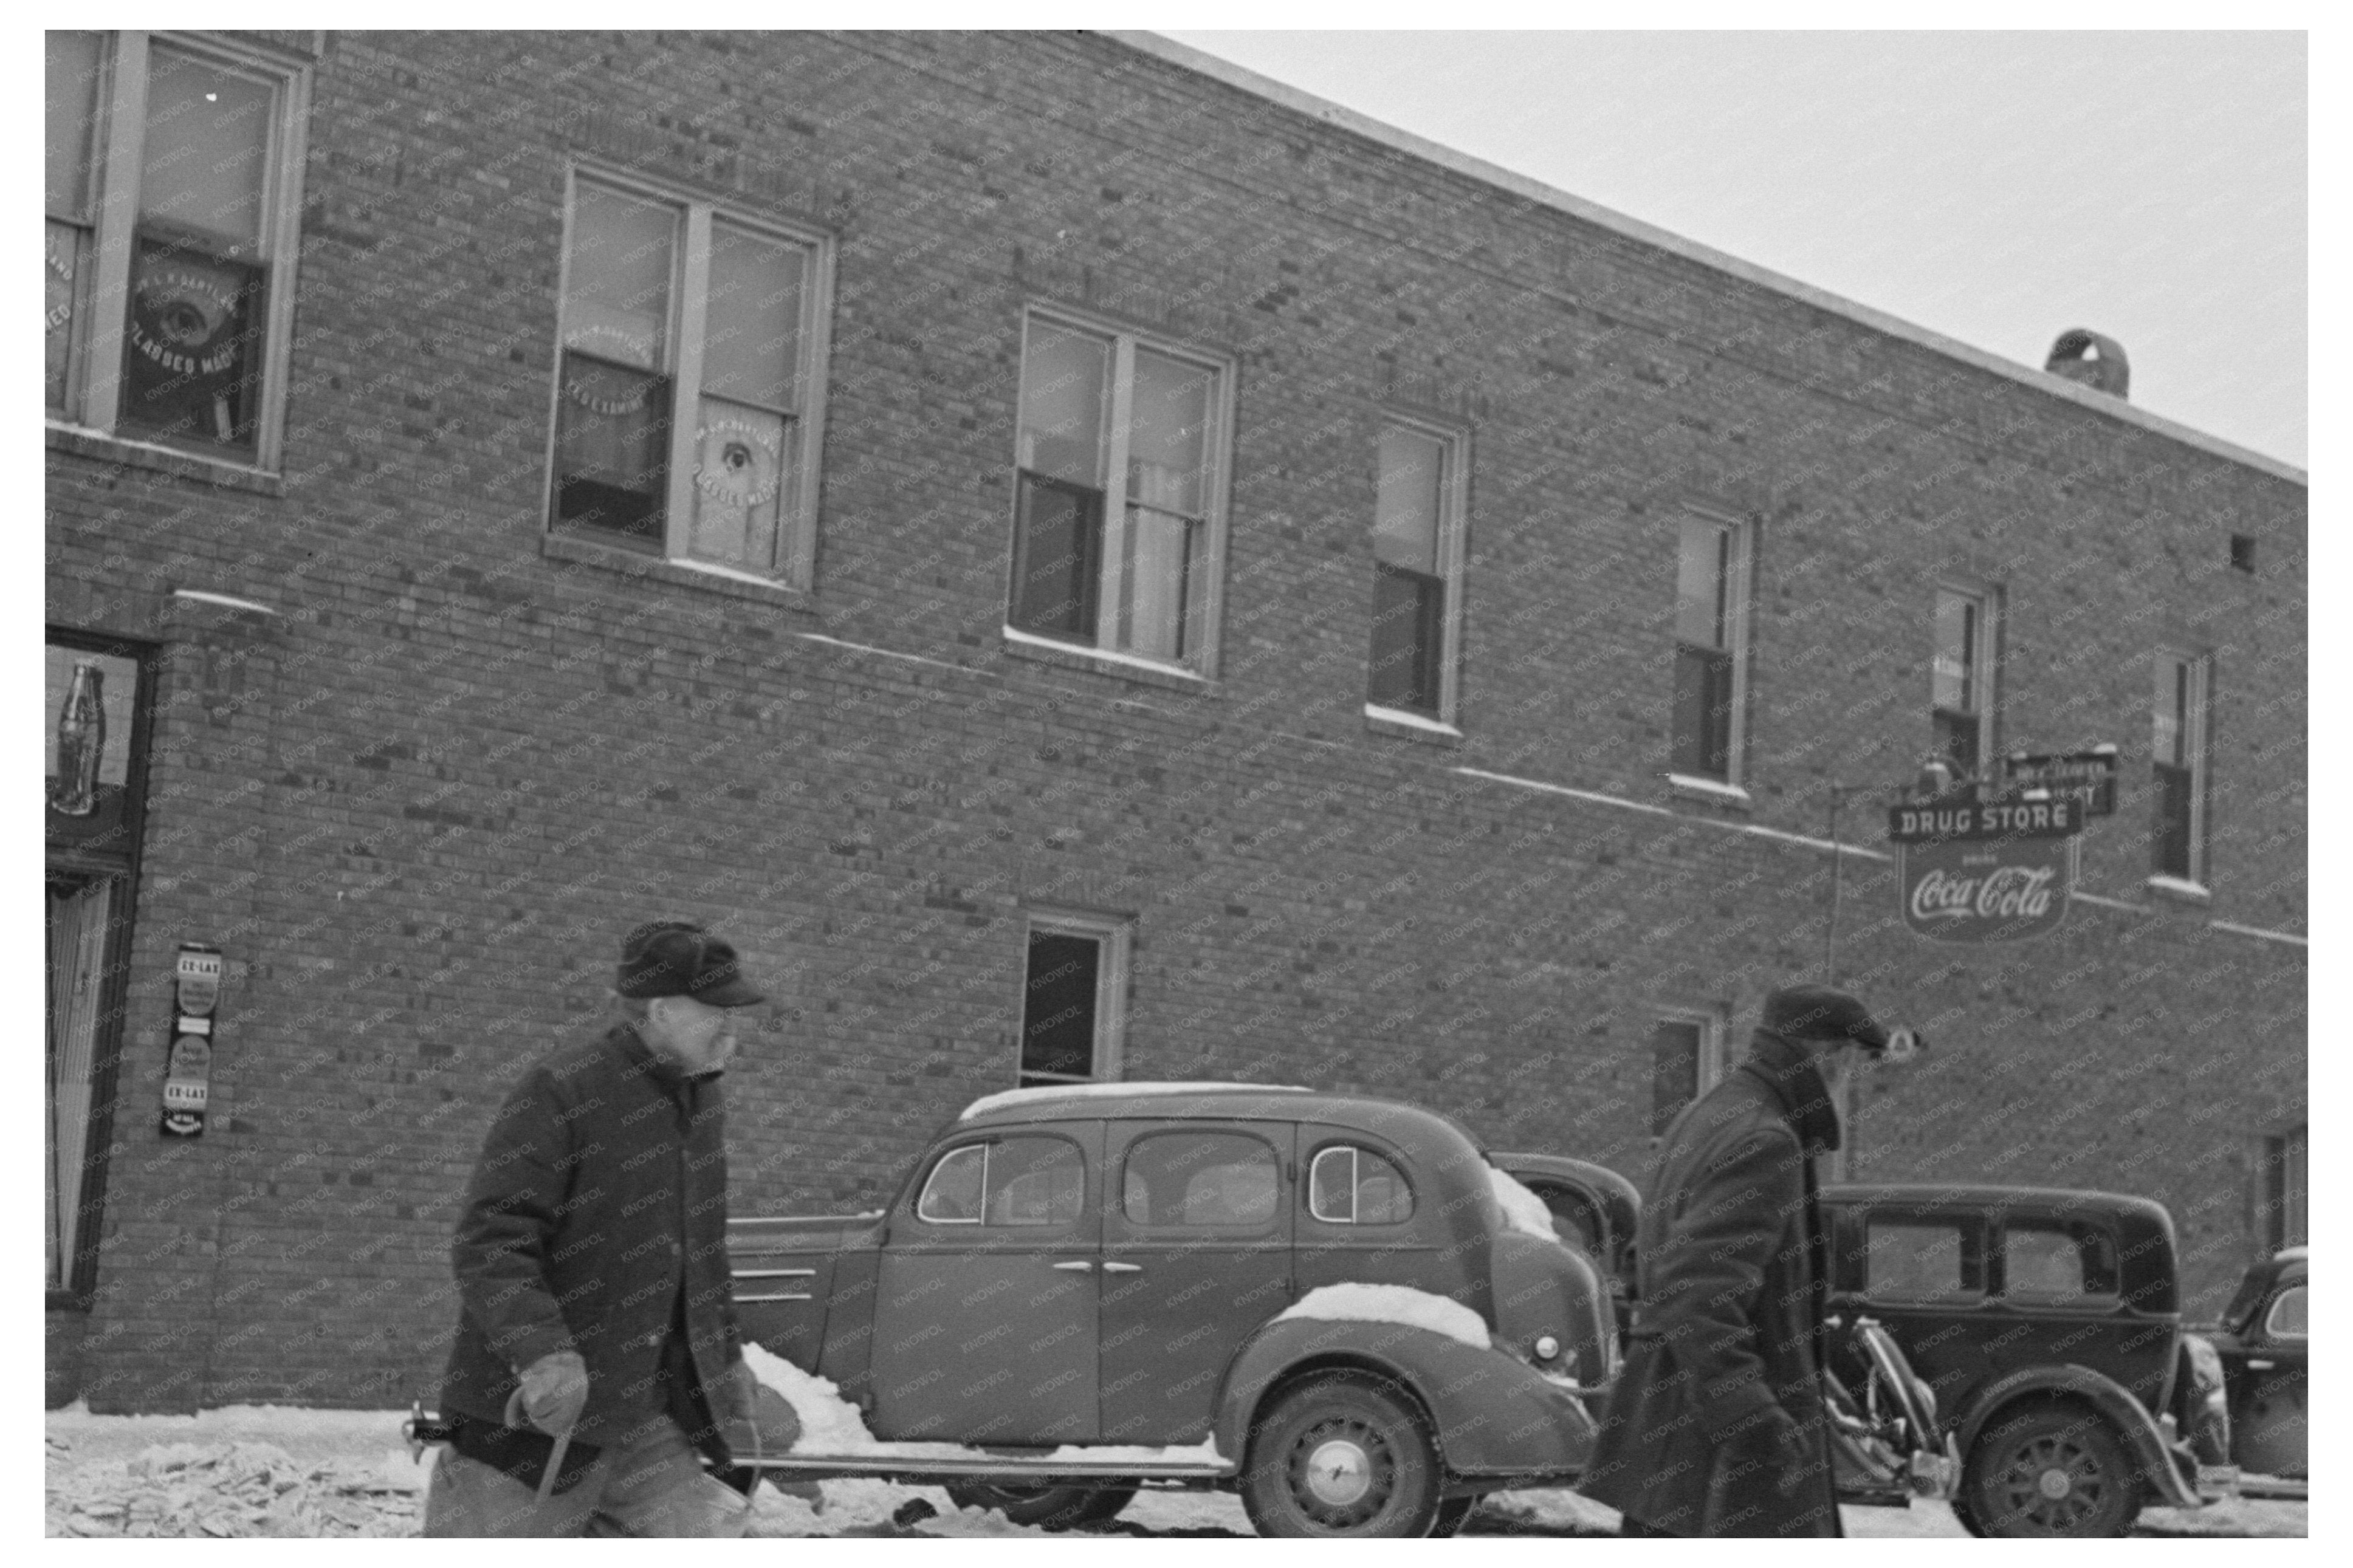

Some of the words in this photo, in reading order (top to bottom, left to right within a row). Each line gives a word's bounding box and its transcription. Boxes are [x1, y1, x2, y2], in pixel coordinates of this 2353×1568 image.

[1901, 809, 1971, 834] DRUG
[1981, 804, 2069, 830] STORE
[182, 960, 219, 974] EX-LAX
[168, 1086, 205, 1100] EX-LAX
